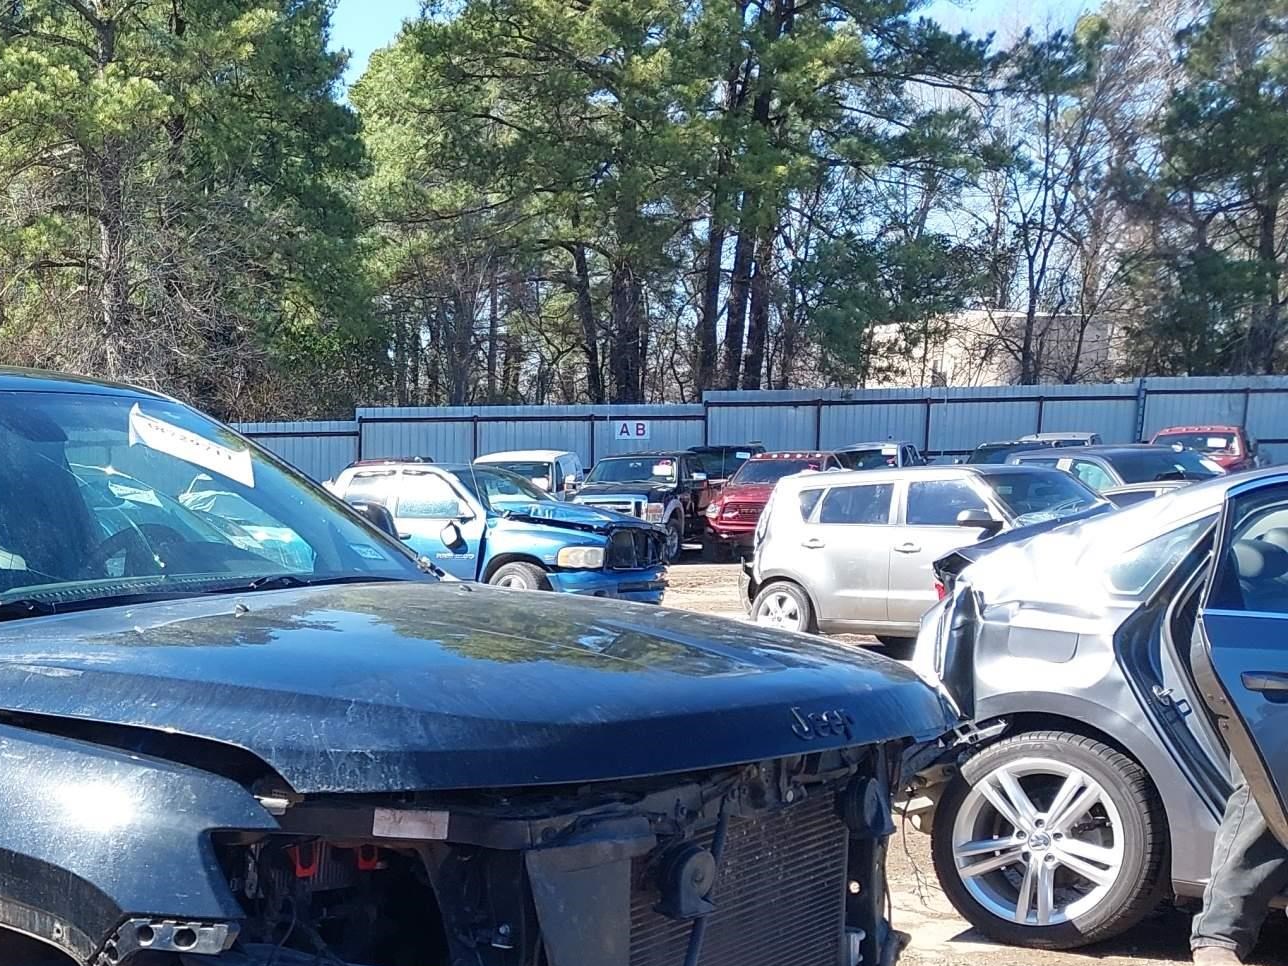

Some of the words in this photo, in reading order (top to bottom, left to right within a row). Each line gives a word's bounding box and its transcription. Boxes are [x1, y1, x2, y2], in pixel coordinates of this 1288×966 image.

[619, 422, 630, 437] A
[636, 422, 647, 437] B
[791, 706, 855, 742] Jeep
